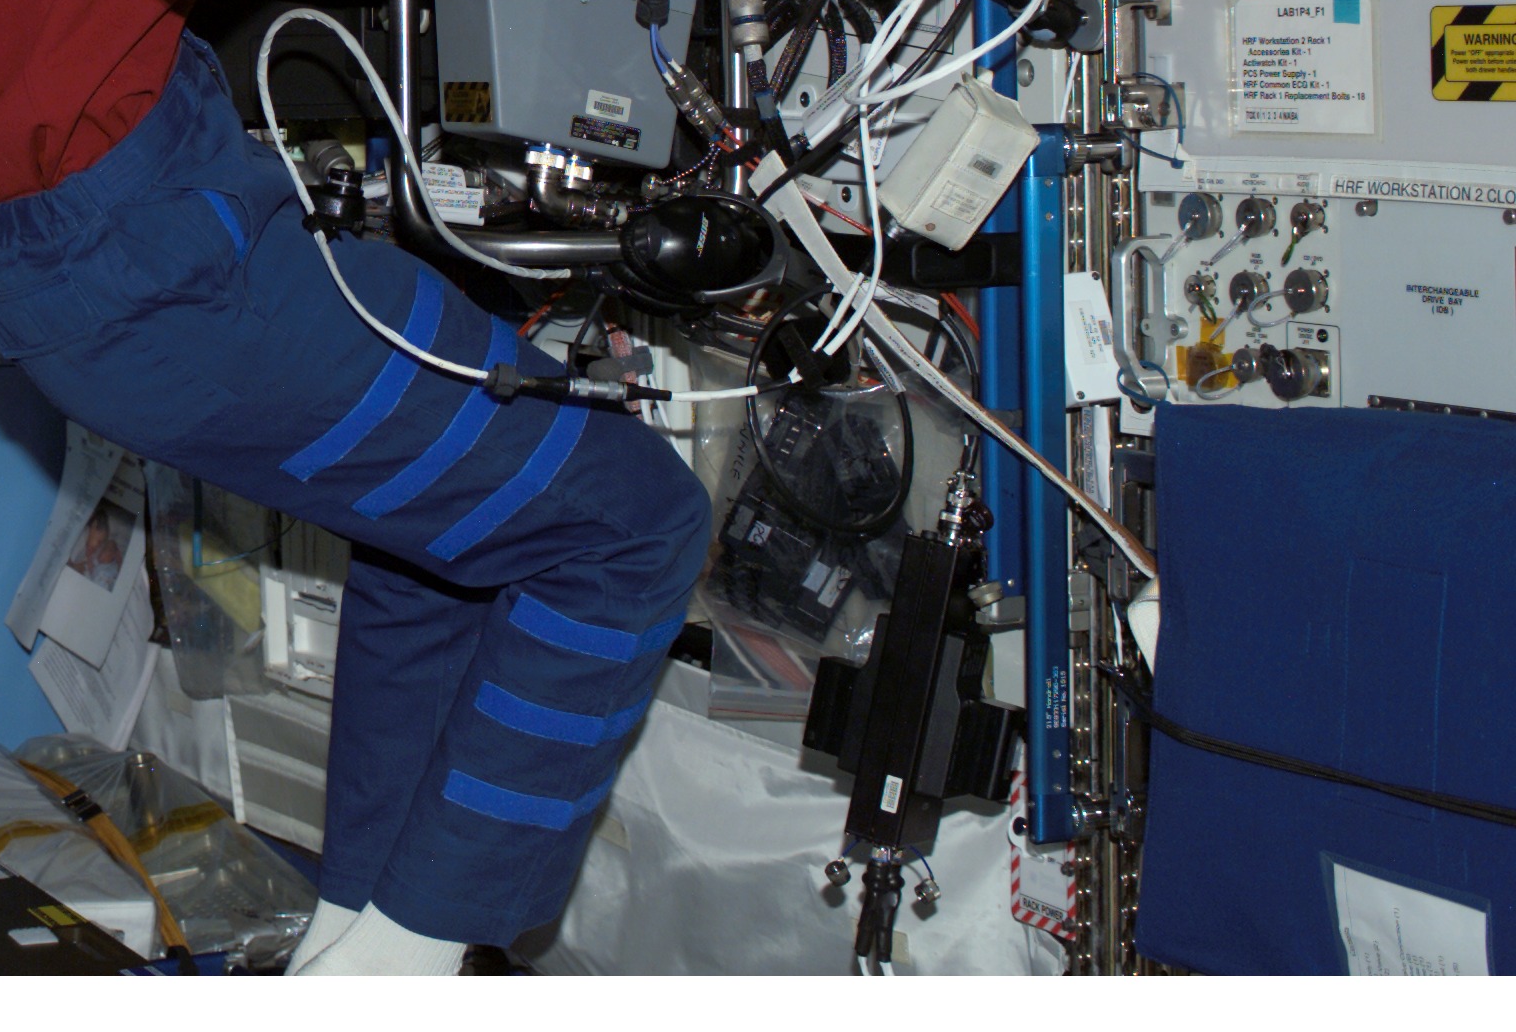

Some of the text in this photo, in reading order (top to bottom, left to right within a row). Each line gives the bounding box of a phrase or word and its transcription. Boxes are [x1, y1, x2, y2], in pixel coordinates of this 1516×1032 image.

[1277, 7, 1325, 18] LAB1P4_F1
[1242, 36, 1257, 45] HRF
[1258, 37, 1299, 45] Workstation
[1307, 36, 1325, 44] Rack
[1248, 48, 1290, 56] Accessories
[1243, 70, 1258, 78] PCS
[1259, 70, 1280, 78] Power
[1282, 70, 1306, 79] Supply
[1243, 81, 1258, 89] HRF
[1259, 81, 1290, 89] Common
[1243, 92, 1258, 100] HRF
[1259, 92, 1276, 100] Rack
[1284, 92, 1330, 101] Replacement
[1331, 92, 1350, 100] Bolts
[1335, 179, 1364, 194] HRF
[1367, 181, 1471, 201] WORKSTATION
[1475, 188, 1483, 201] 2
[1406, 284, 1479, 298] INTERCHANGEABLE
[1422, 295, 1463, 306] DRIVE BAY
[1022, 897, 1065, 921] RACK POWER
